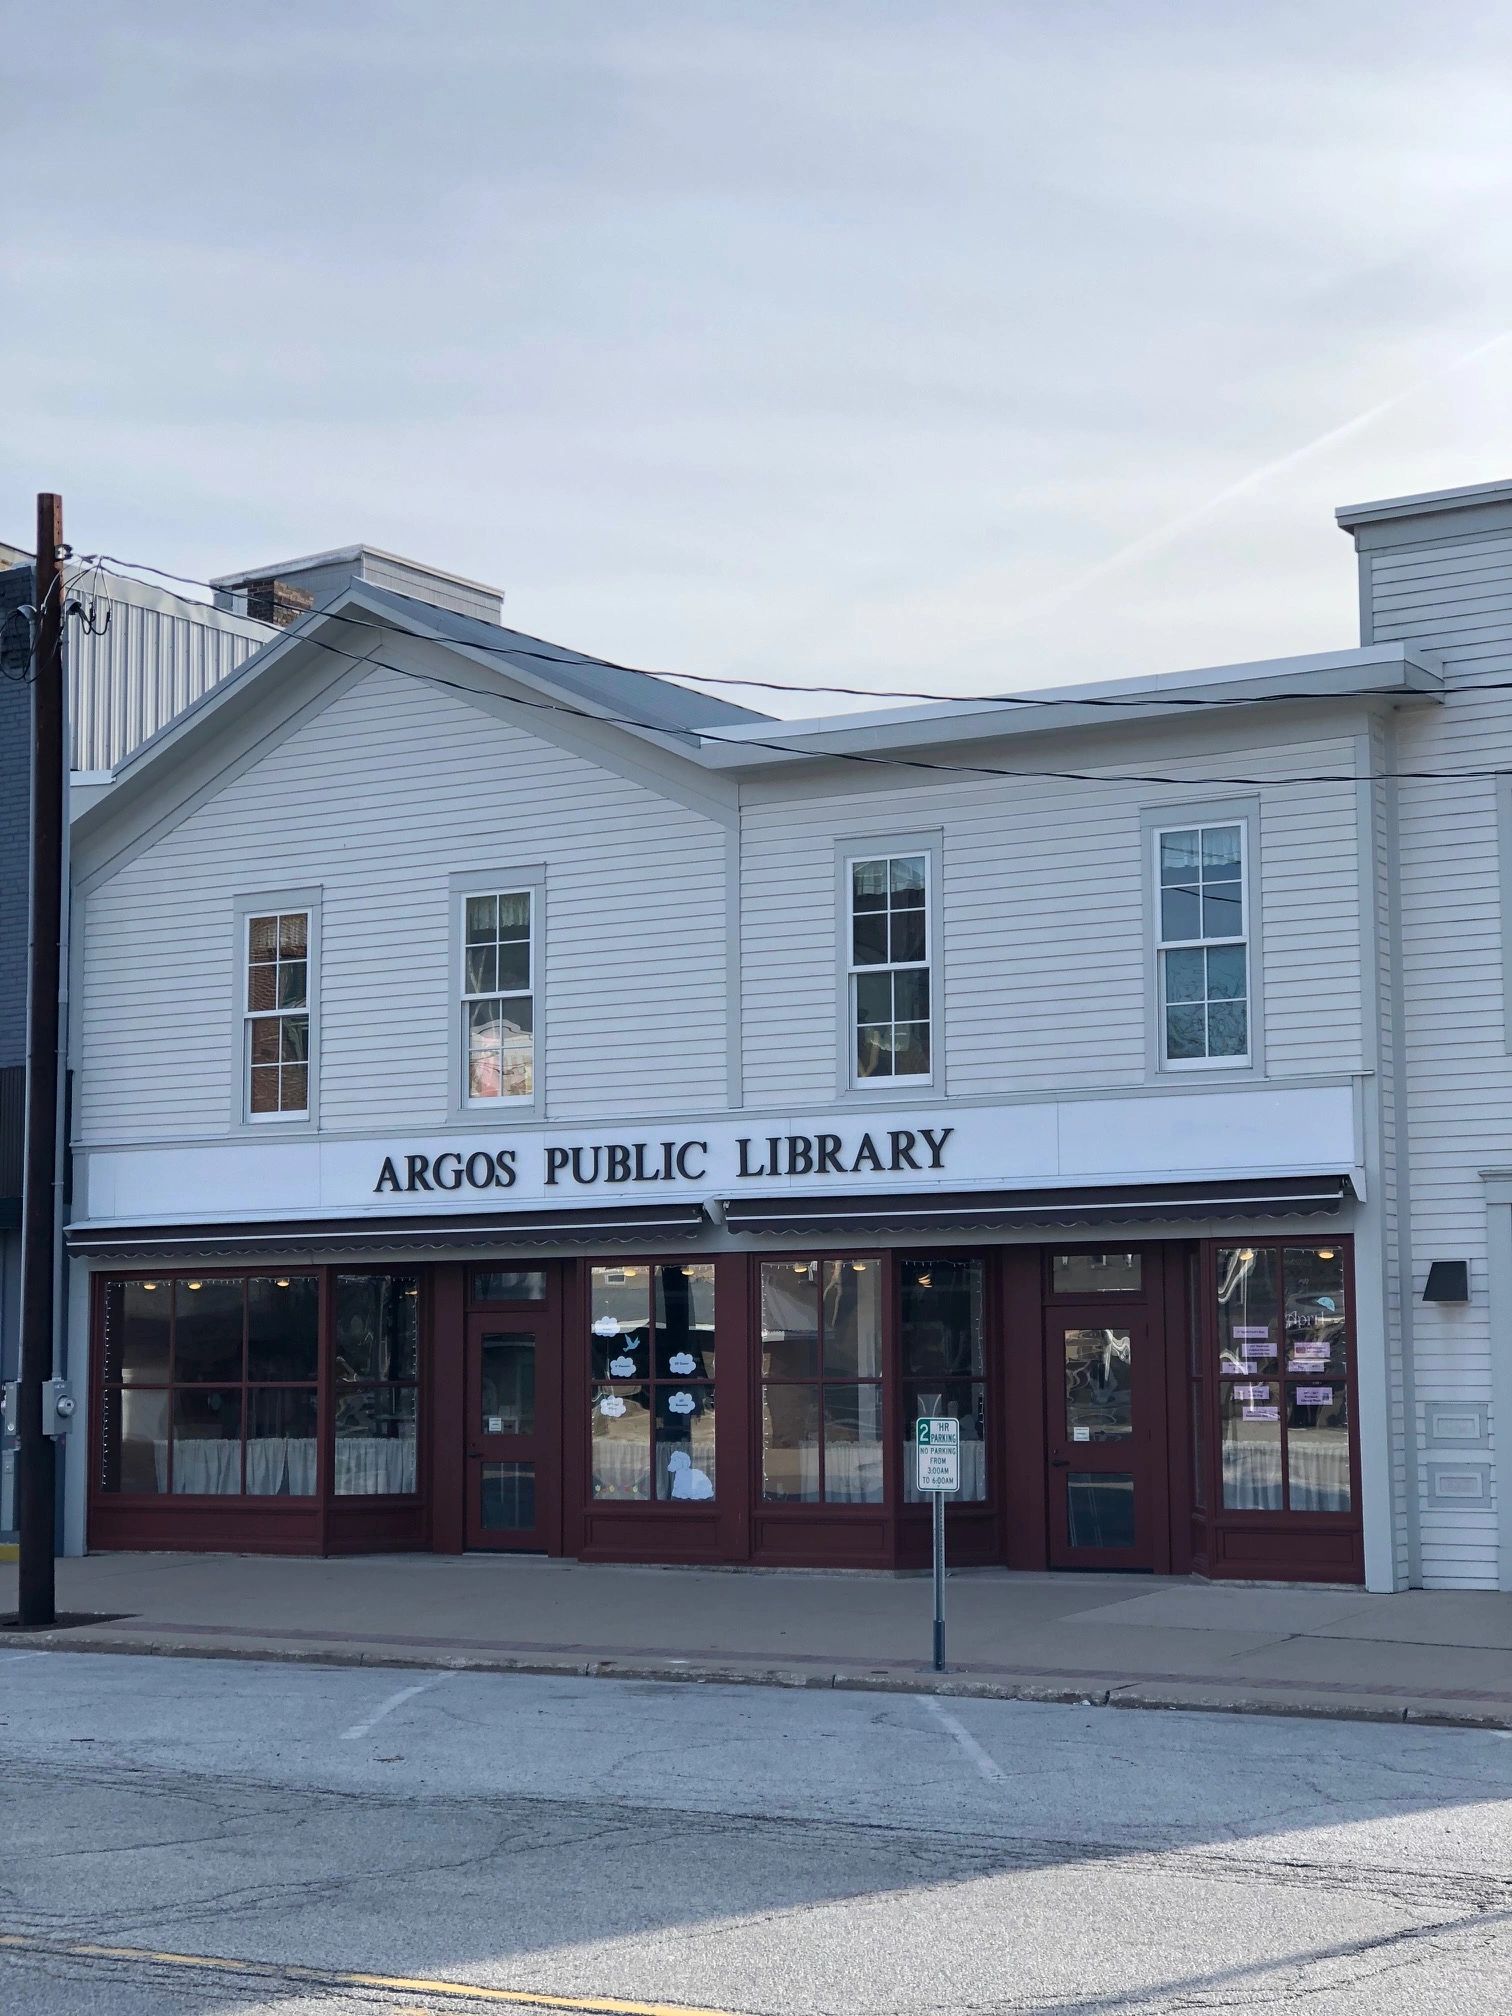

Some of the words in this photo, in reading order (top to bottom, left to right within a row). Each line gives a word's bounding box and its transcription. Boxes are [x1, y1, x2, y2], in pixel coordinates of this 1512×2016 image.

[373, 1149, 517, 1193] ARGOS
[544, 1141, 708, 1185] PUBLIC
[735, 1127, 954, 1178] LIBRARY
[1285, 1310, 1325, 1329] April
[920, 1424, 929, 1442] 2
[939, 1423, 949, 1431] HR
[931, 1434, 956, 1443] PARKING
